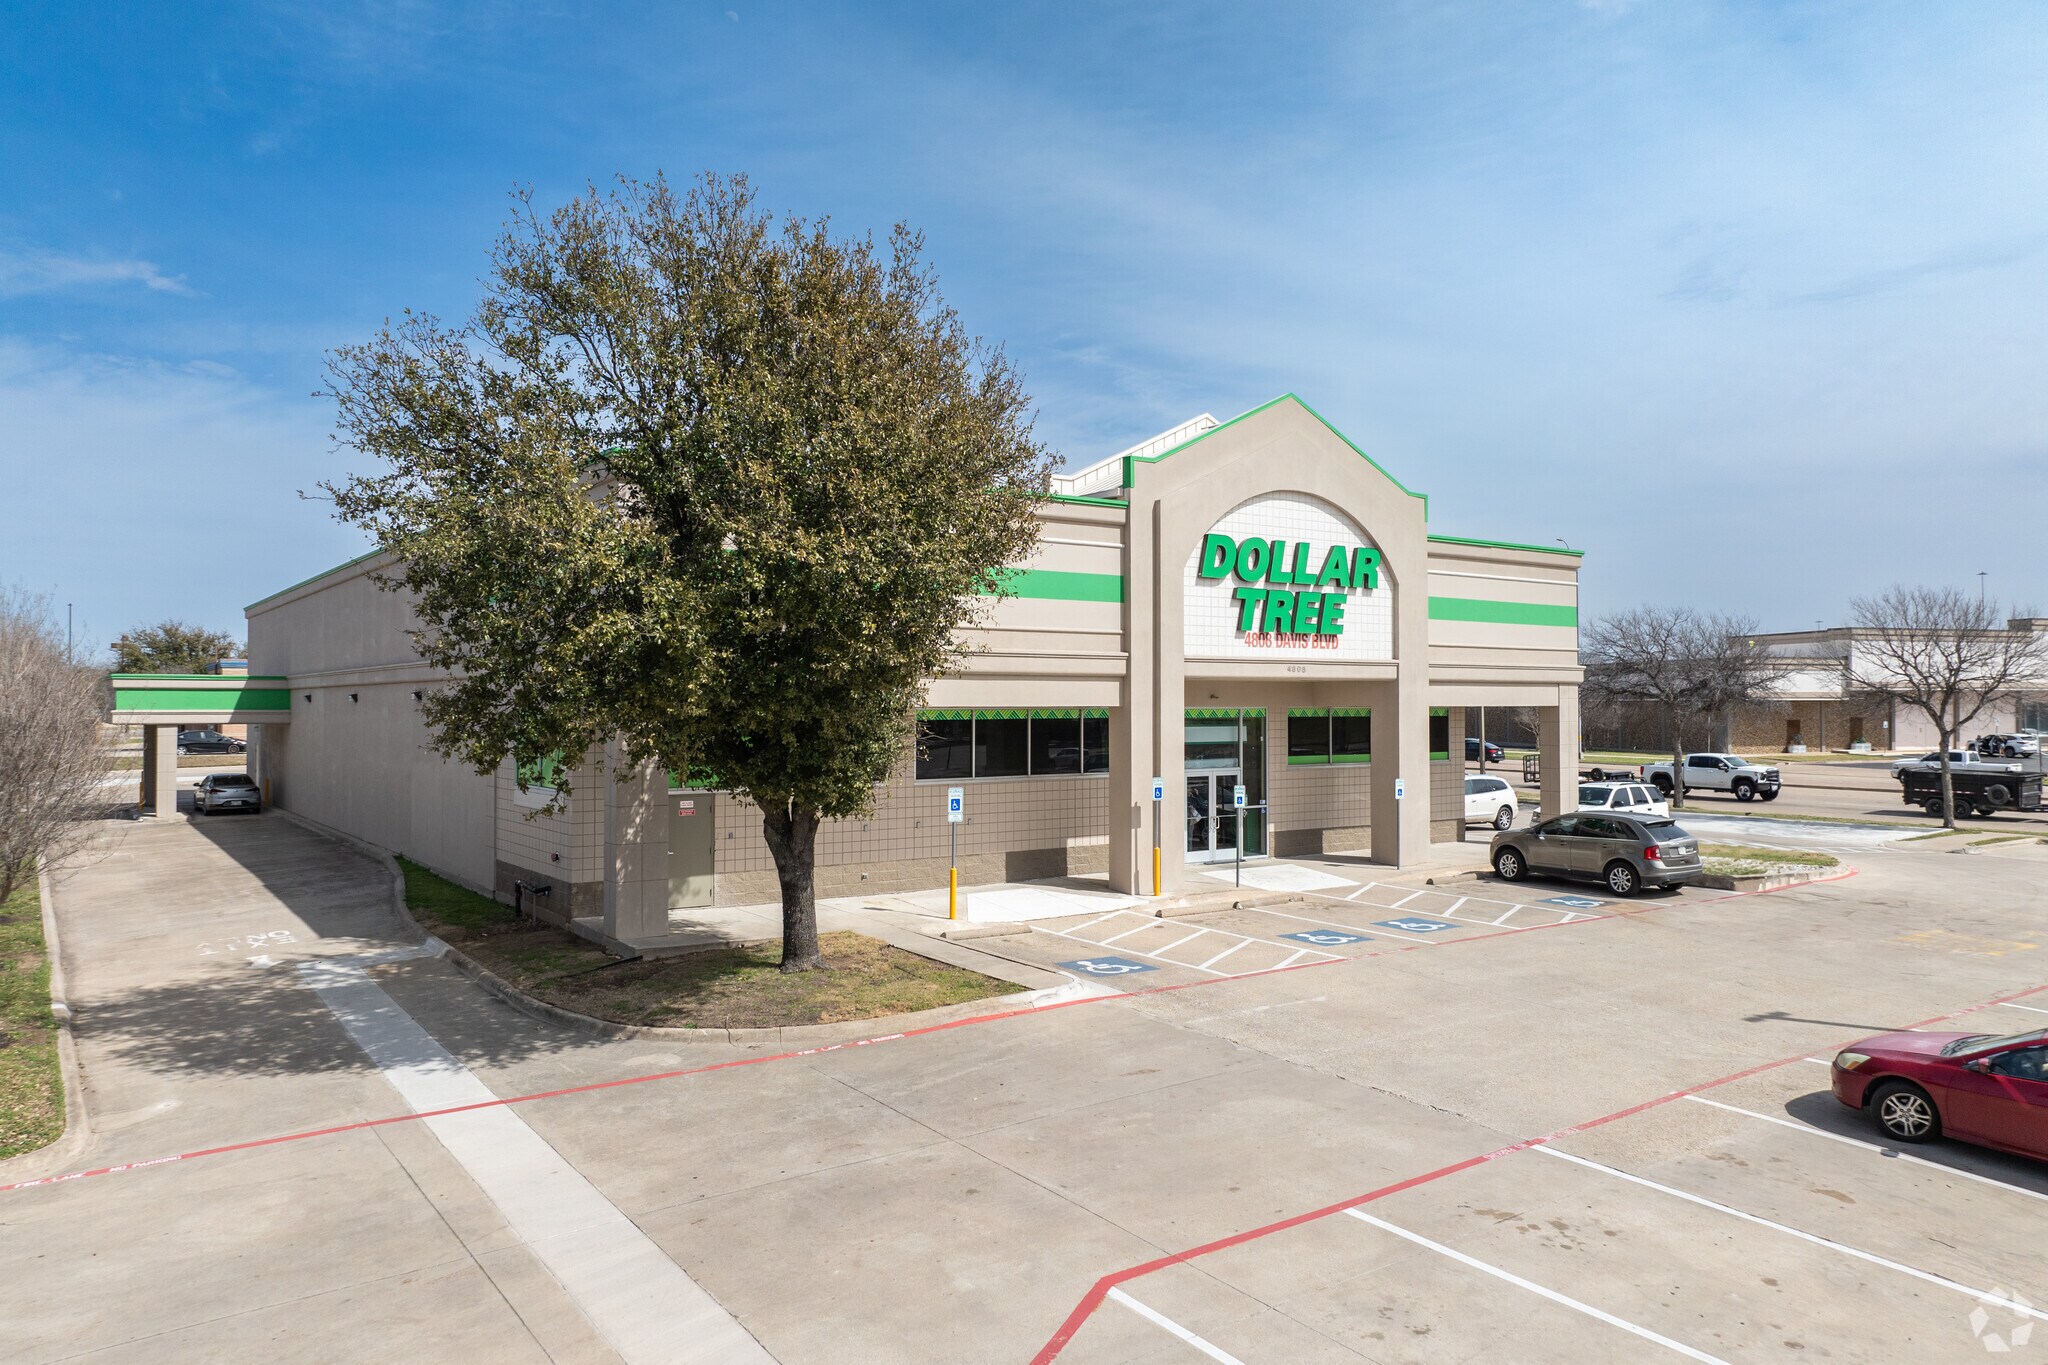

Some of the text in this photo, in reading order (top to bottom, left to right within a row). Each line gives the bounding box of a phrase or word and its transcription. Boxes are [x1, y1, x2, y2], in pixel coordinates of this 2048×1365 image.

[1198, 533, 1381, 589] DOLLAR
[1233, 587, 1347, 634] TREE
[1244, 631, 1339, 649] 4808 DAVIS BLVD
[1286, 665, 1306, 673] 4808
[14, 1180, 43, 1189] FIRE
[51, 1172, 86, 1182] LANE
[131, 1156, 182, 1168] PARKING
